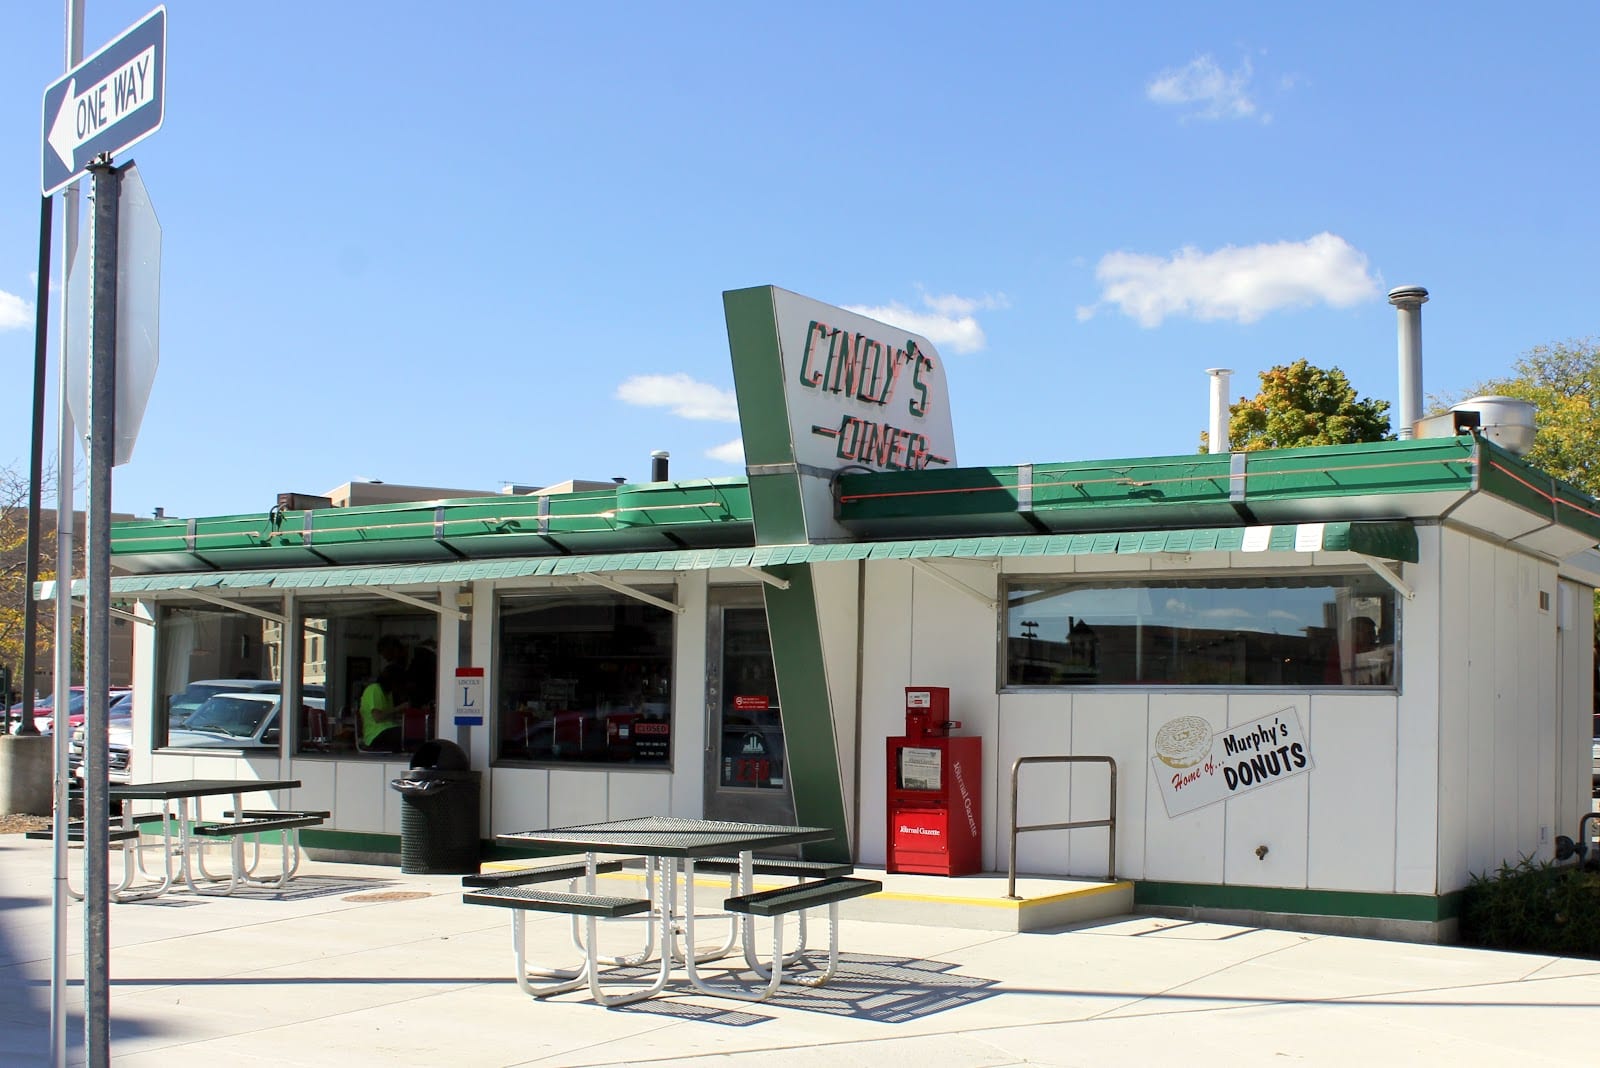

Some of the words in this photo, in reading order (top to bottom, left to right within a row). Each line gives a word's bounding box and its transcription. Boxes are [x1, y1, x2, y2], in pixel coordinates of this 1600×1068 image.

[76, 83, 108, 140] ONE
[114, 55, 150, 116] WAY
[800, 320, 936, 418] CINDY'S
[837, 414, 931, 471] DINER
[463, 686, 475, 707] L
[1222, 717, 1289, 757] Murphy's
[1171, 767, 1202, 792] Home
[1223, 742, 1307, 791] DONUTS
[964, 797, 978, 838] Gazette
